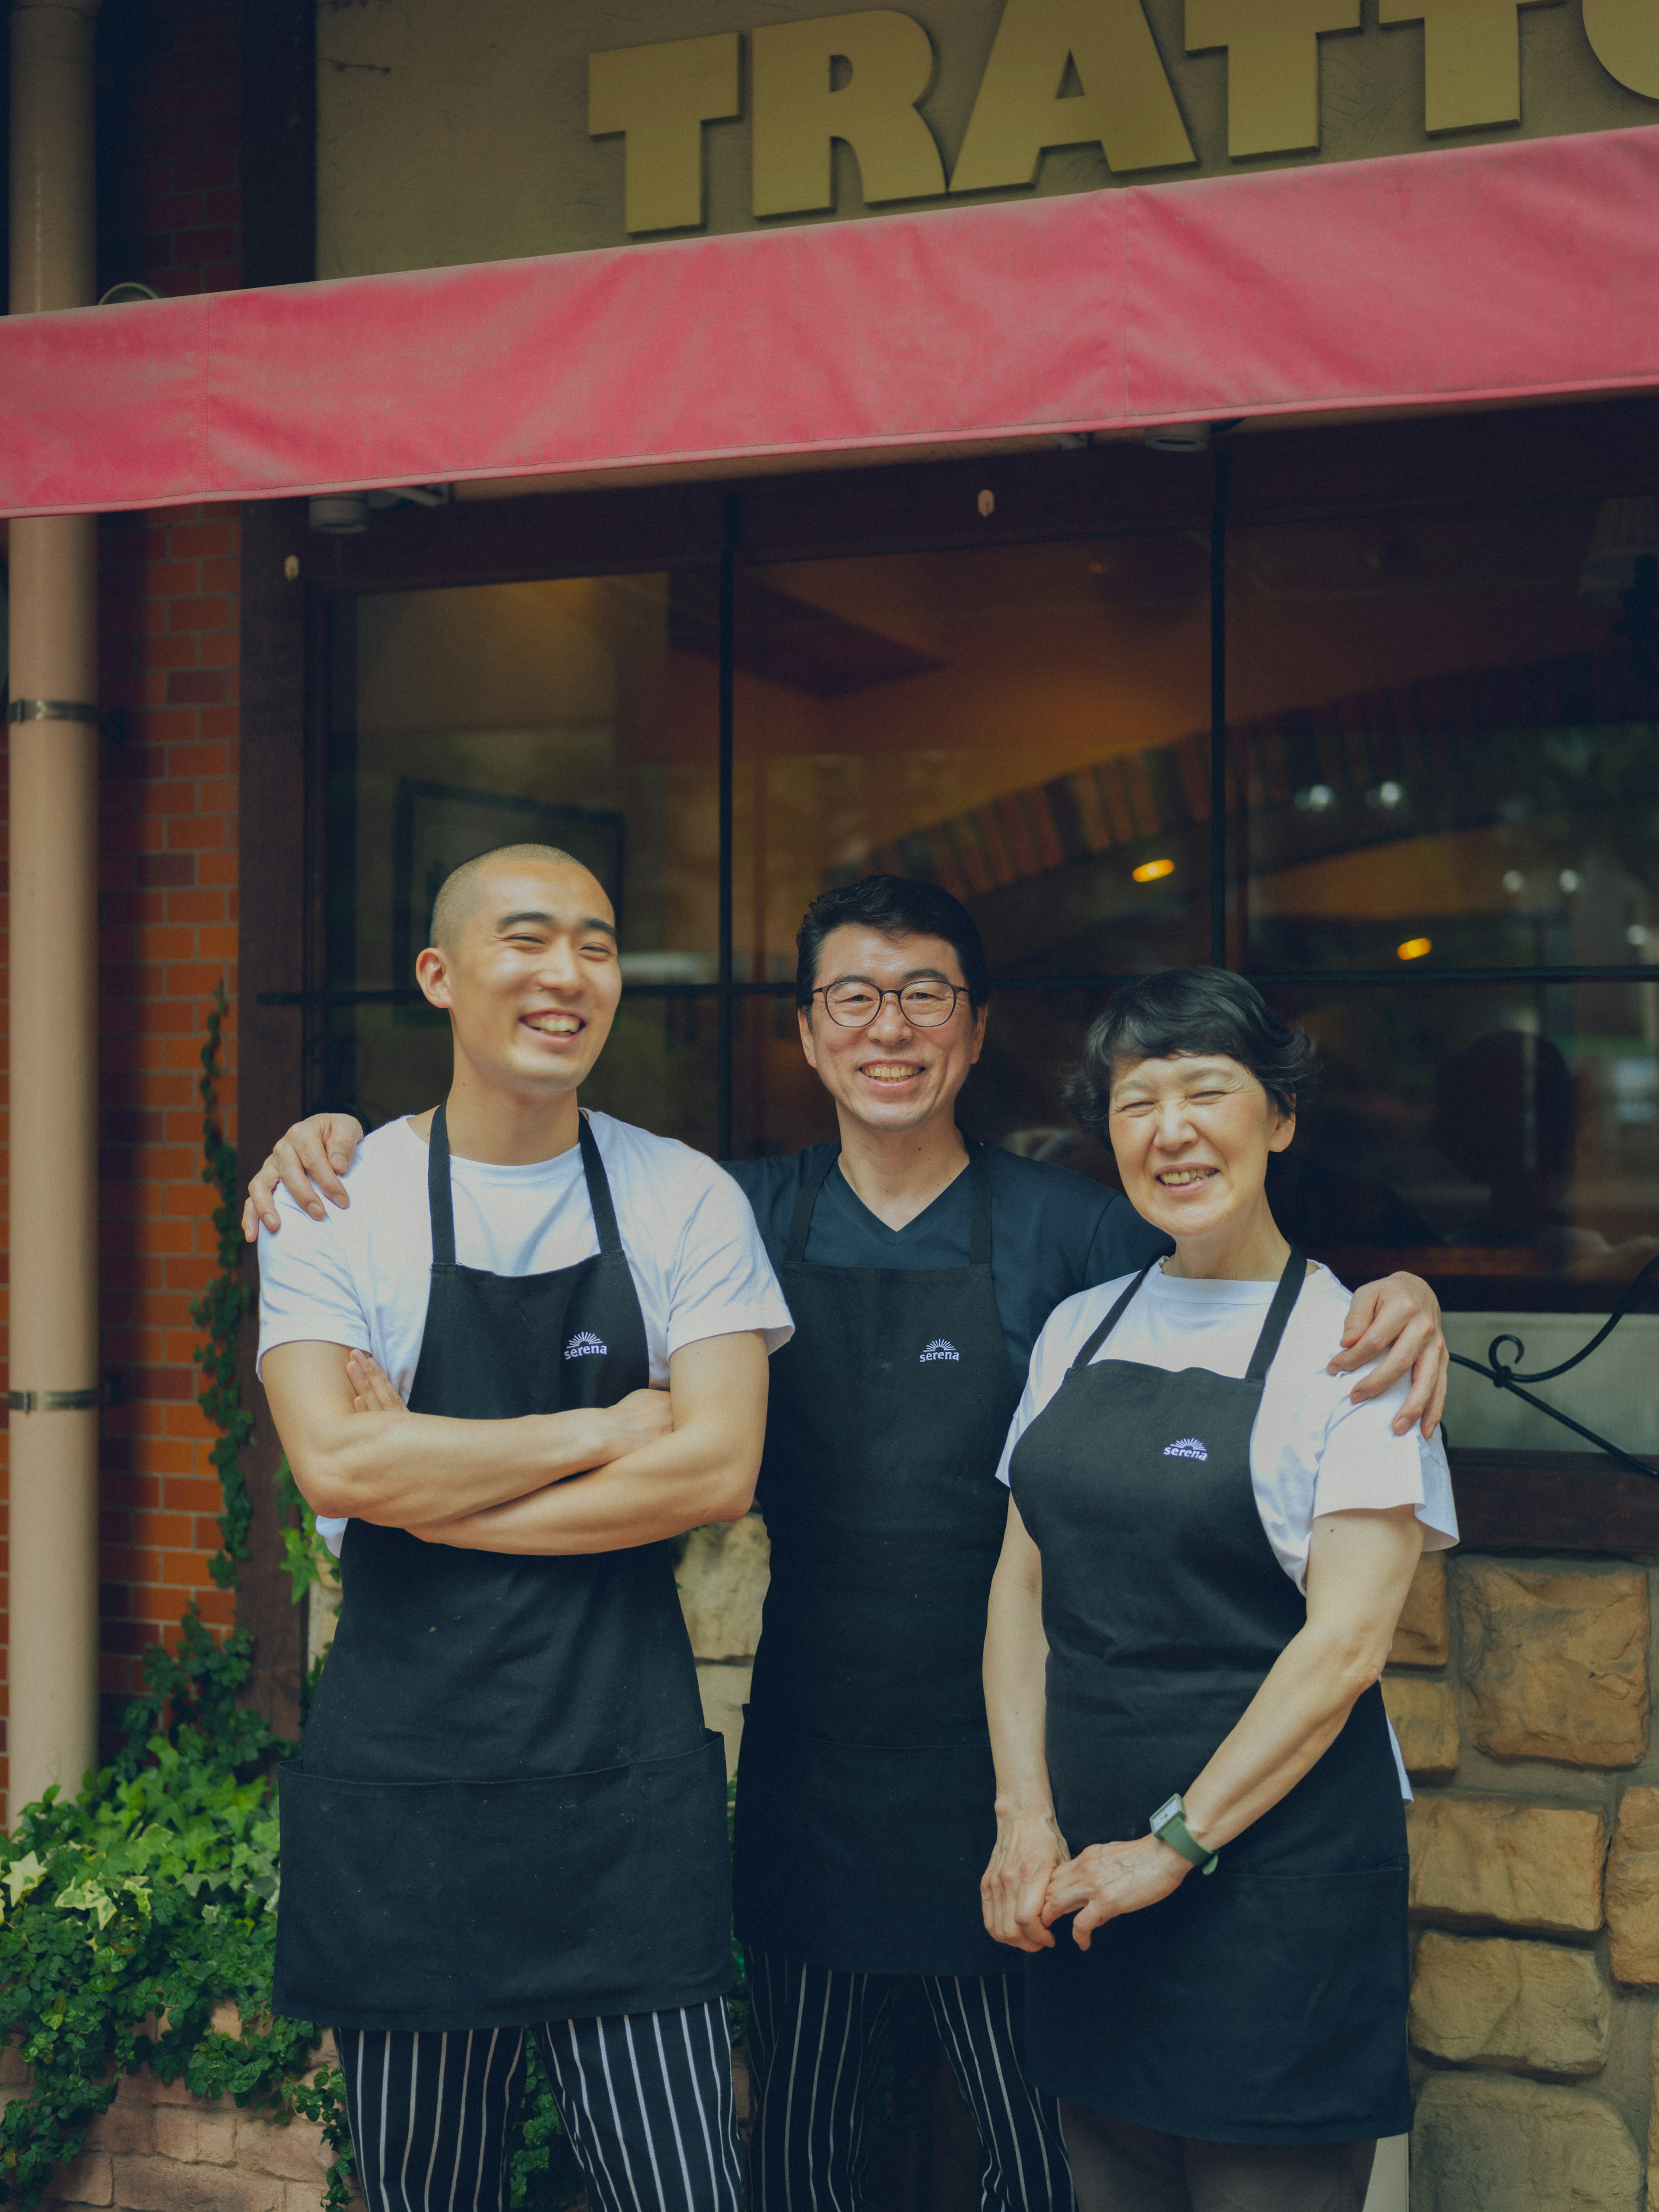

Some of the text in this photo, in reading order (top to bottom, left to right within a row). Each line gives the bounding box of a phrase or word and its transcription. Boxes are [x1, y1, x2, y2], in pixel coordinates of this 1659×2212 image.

[588, 0, 1659, 236] TRATT
[564, 1345, 607, 1360] serena
[919, 1351, 959, 1362] serena
[1163, 1446, 1208, 1461] serena
